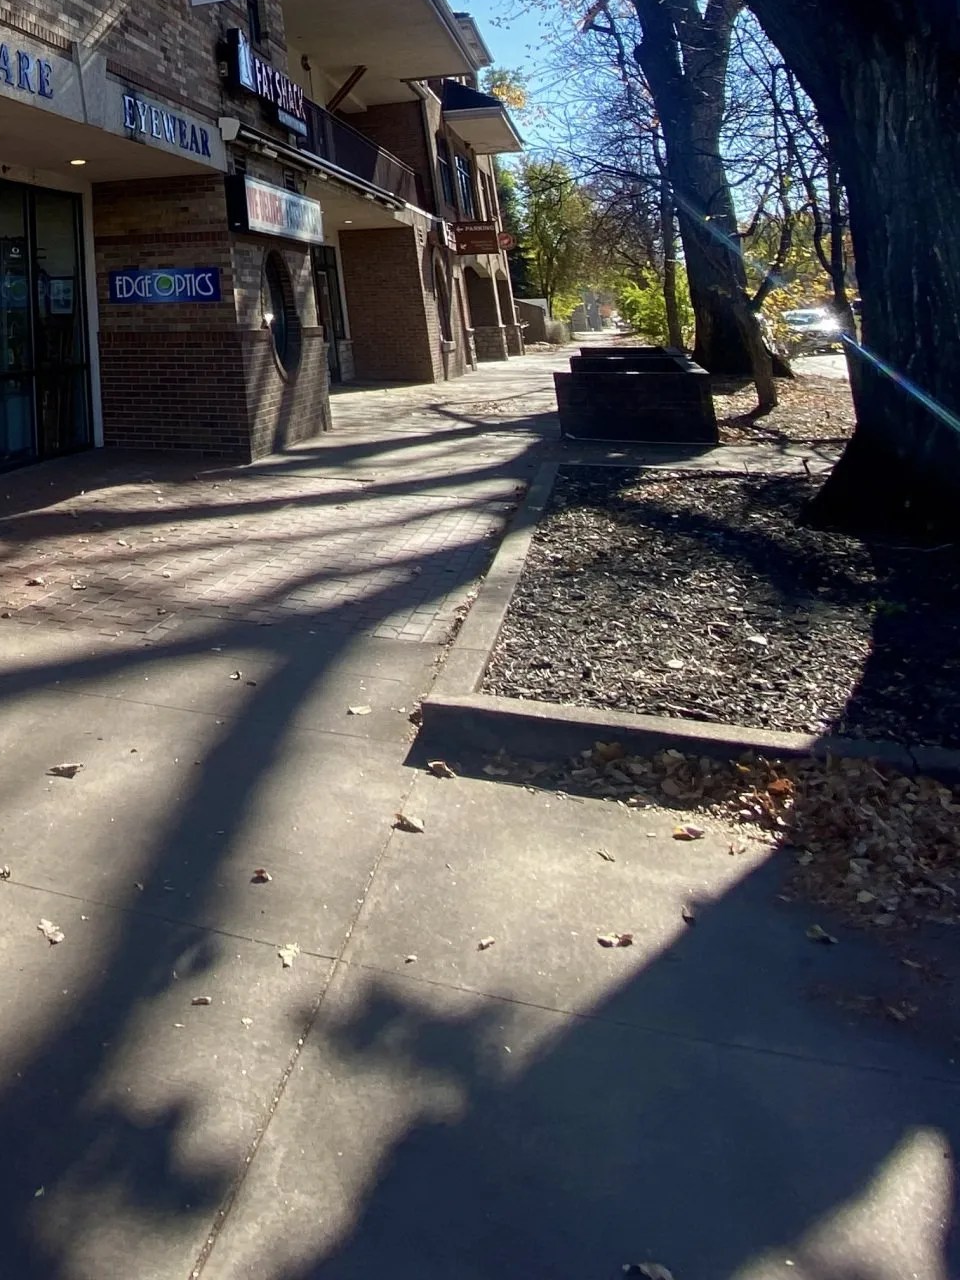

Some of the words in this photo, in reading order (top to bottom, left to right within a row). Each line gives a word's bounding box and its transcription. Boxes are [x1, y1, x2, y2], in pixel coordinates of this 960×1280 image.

[254, 57, 275, 103] FAT
[275, 70, 307, 121] SHACK
[123, 94, 211, 158] EYEWEAR
